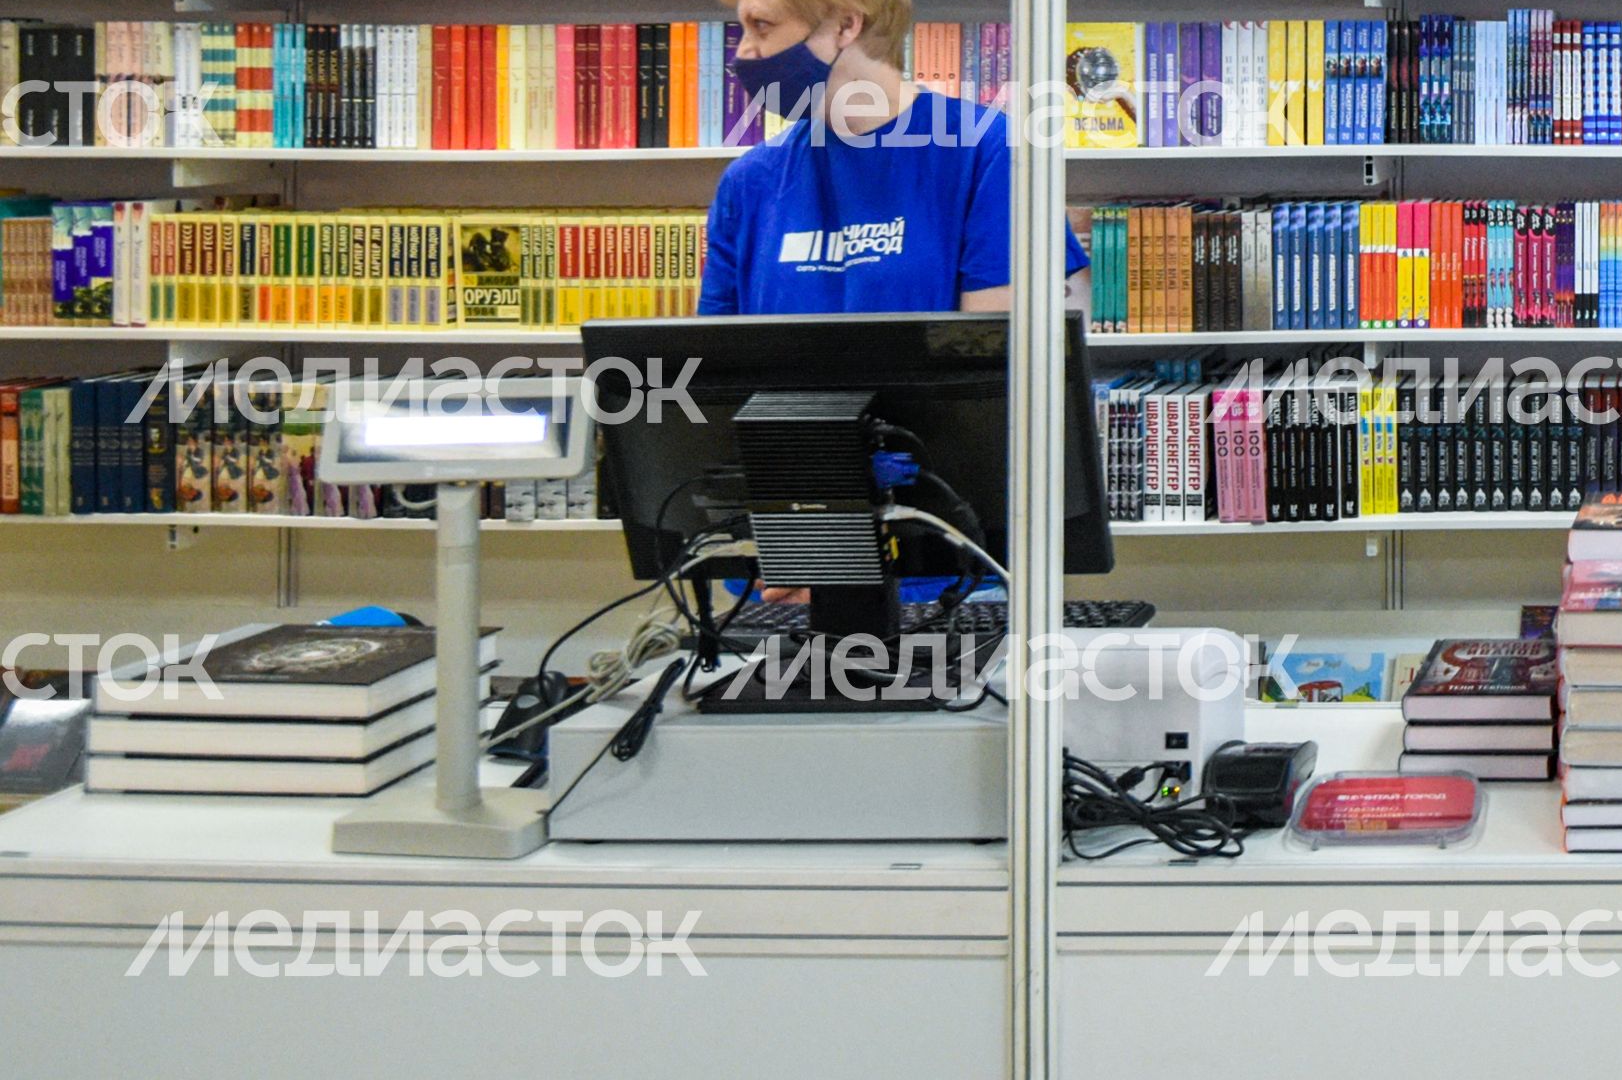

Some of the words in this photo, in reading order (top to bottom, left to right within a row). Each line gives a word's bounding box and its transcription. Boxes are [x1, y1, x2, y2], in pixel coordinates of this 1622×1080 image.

[1074, 117, 1125, 132] ВЕДЬМА
[182, 225, 194, 251] ГЕССЕ
[203, 225, 215, 251] ГЕССЕ
[223, 225, 233, 251] ГЕССЕ
[338, 225, 348, 253] КАМЮ
[353, 226, 363, 242] ЛИ
[371, 226, 381, 242] ЛИ
[564, 227, 573, 253] РЕМАРК
[606, 227, 615, 253] РЕМАРК
[842, 216, 905, 240] ЧИТАЙ
[391, 226, 401, 259] ЛОНДОН
[428, 226, 438, 259] ЛОНДОН
[843, 236, 904, 255] ГОРОД
[353, 244, 363, 277] ХАРПЕР
[371, 244, 381, 277] ХАРПЕР
[464, 288, 520, 305] ОРУЭЛЛ
[1146, 400, 1159, 491] ШВАРЦЕНЕГГЕР
[1166, 400, 1179, 491] ШВАРЦЕНЕГГЕР
[1186, 400, 1199, 491] ШВАРЦЕНЕГГЕР
[1217, 429, 1228, 457] 100
[1233, 429, 1244, 457] 100
[1249, 429, 1260, 457] 100
